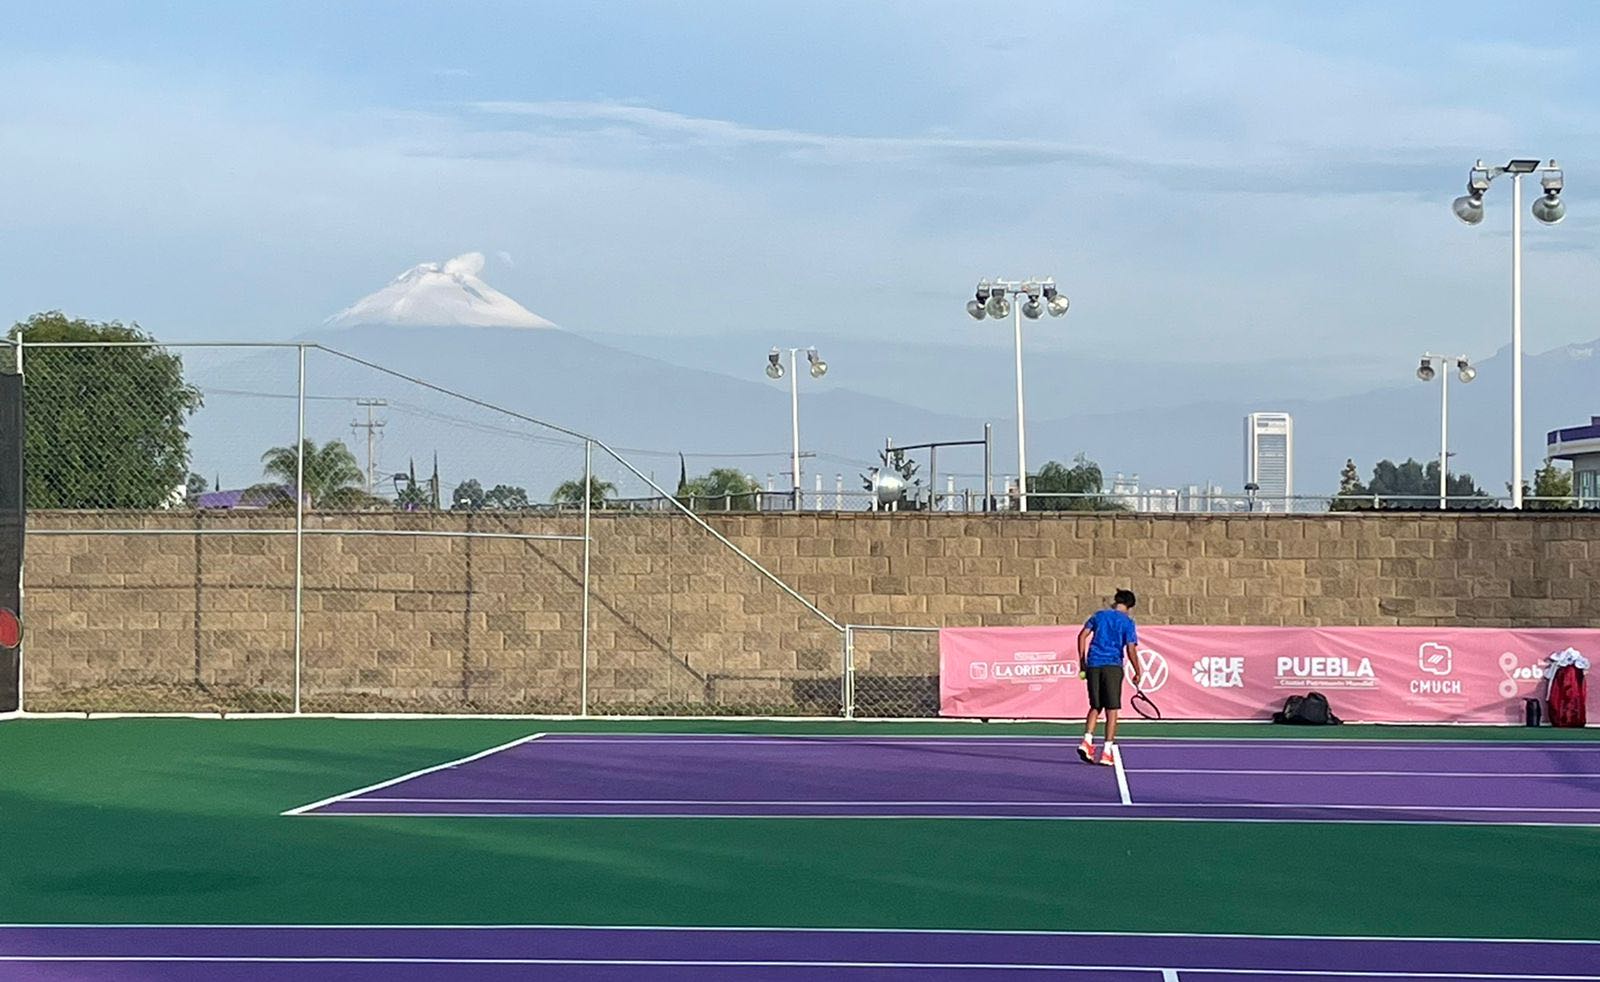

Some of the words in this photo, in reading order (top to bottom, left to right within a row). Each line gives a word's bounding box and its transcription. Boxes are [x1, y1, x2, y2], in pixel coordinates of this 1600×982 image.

[996, 665, 1012, 676] LA
[1014, 663, 1074, 676] ORIENTAL
[1277, 656, 1375, 677] PUEBLA
[1410, 679, 1461, 694] CMUCH
